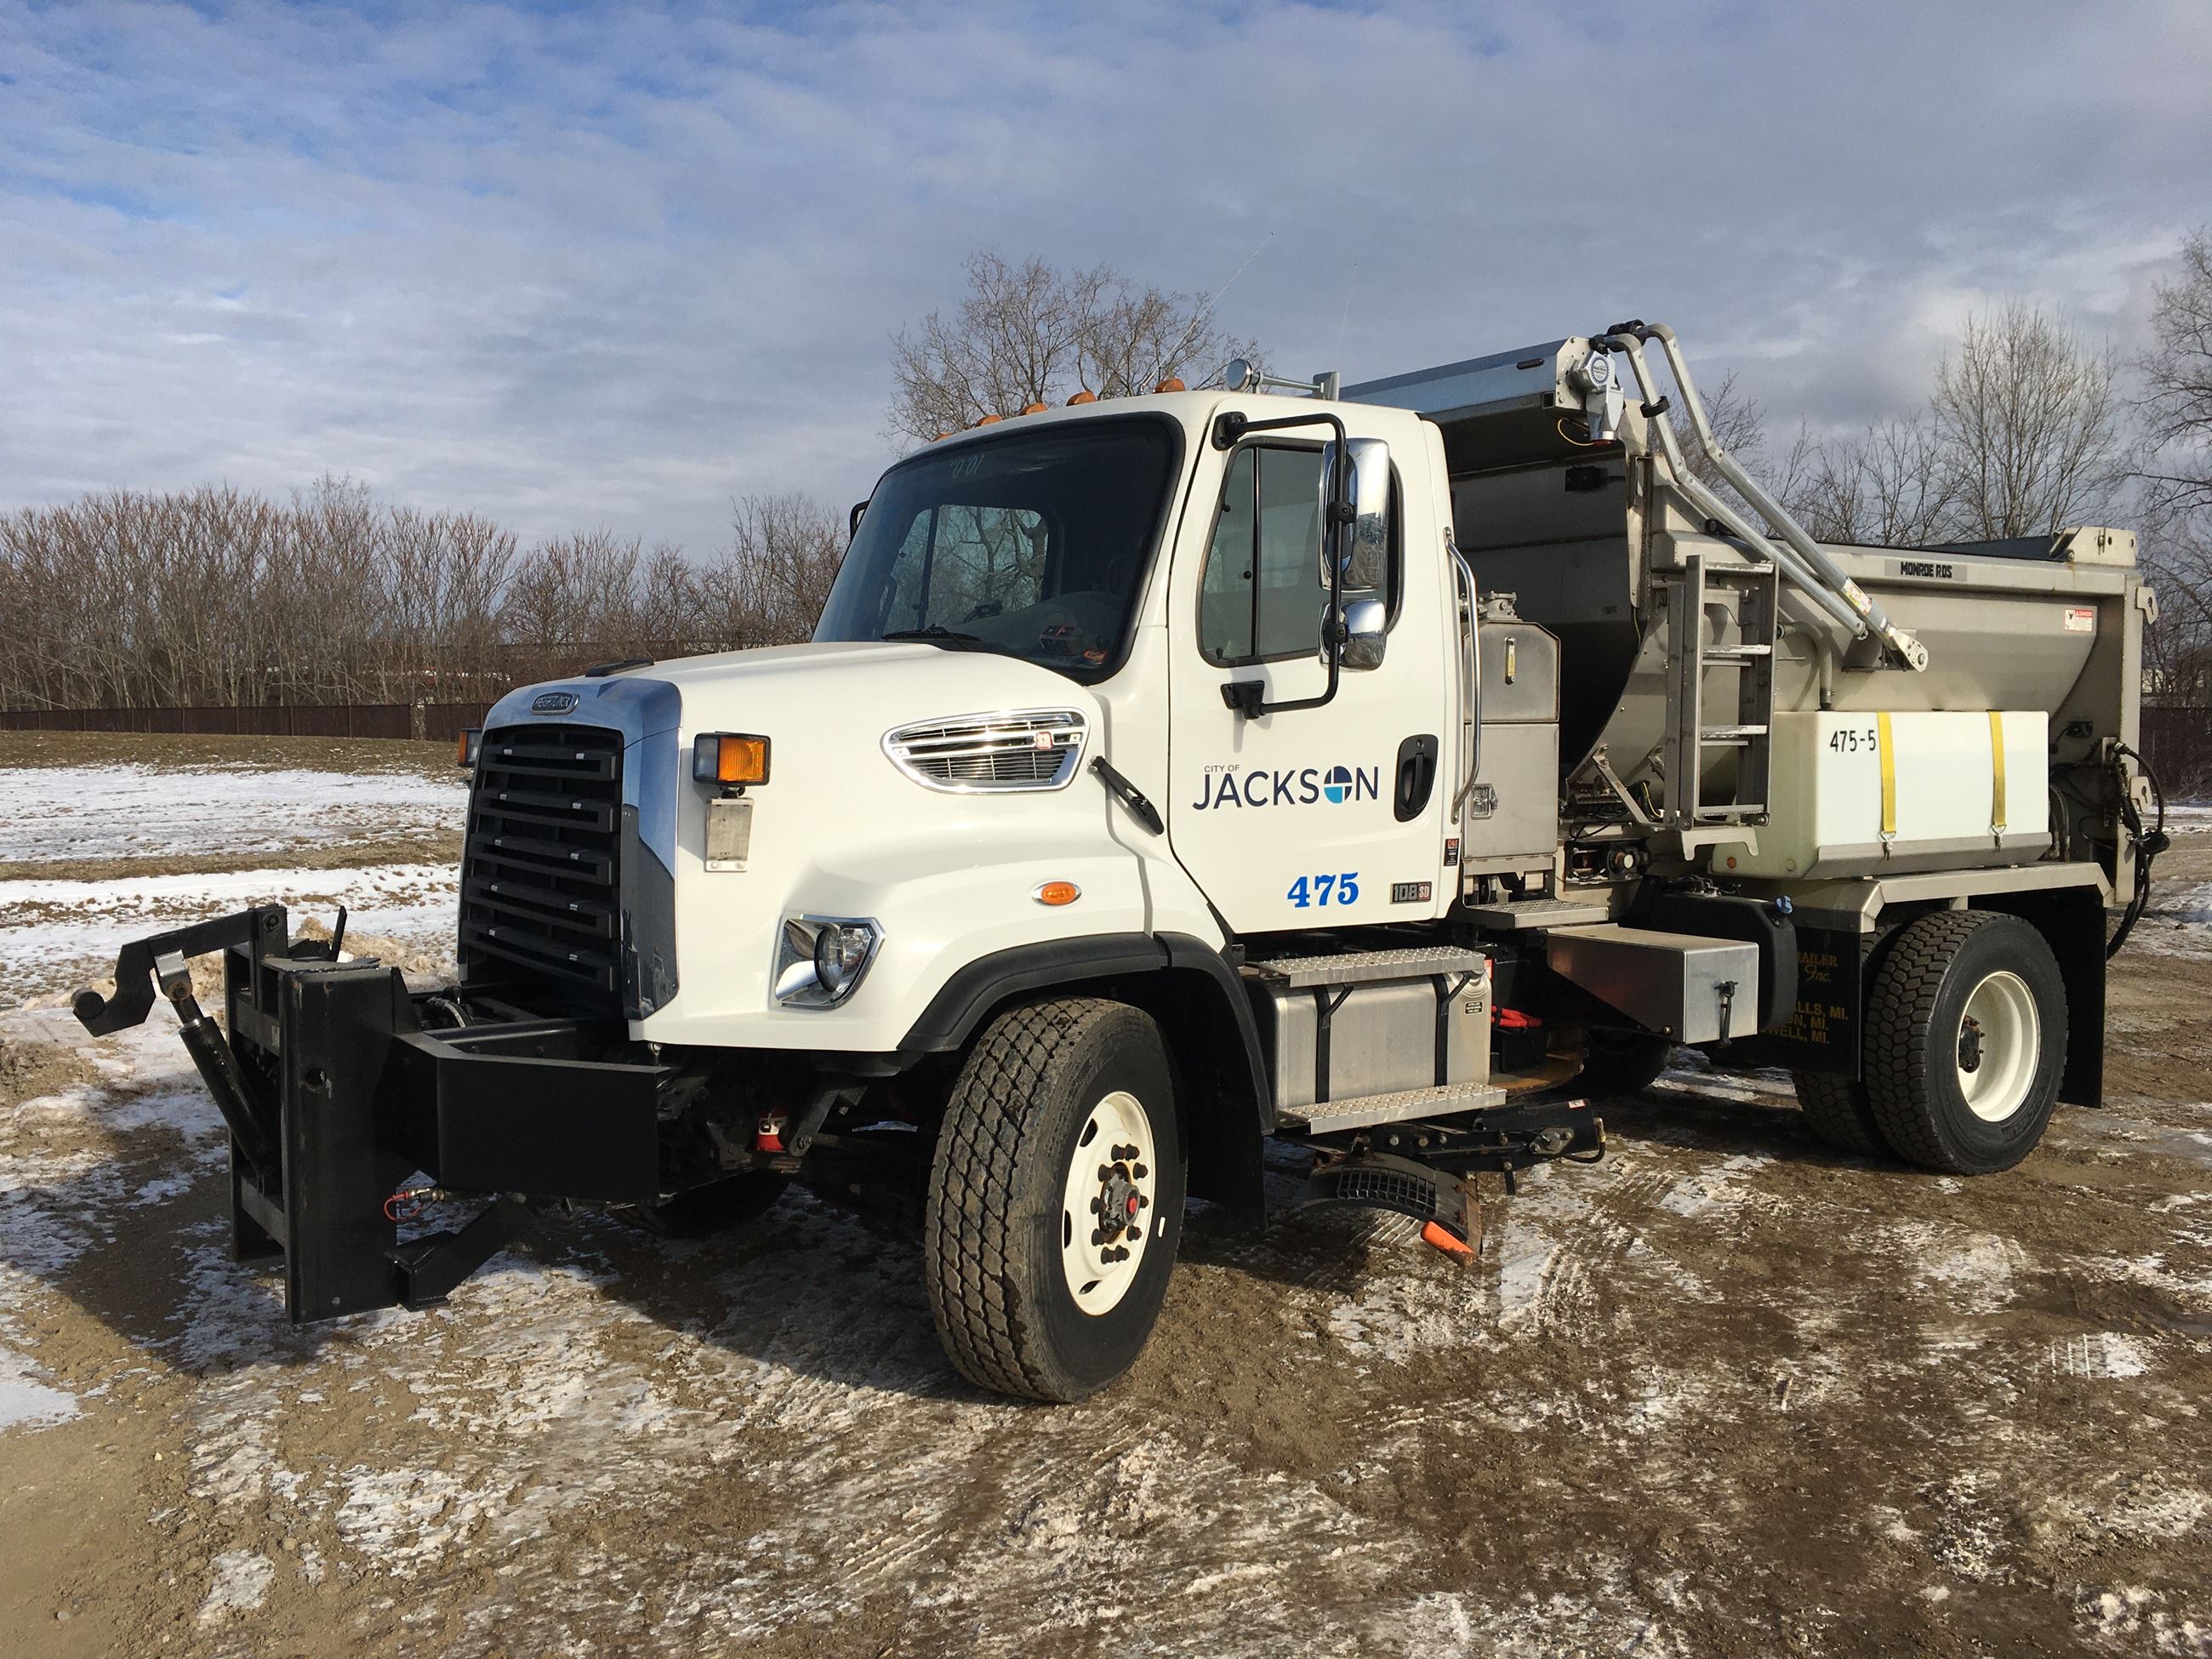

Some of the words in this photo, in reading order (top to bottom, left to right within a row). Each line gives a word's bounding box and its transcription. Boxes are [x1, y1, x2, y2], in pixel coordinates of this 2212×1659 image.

[1900, 562, 1934, 577] MONROE
[1936, 564, 1953, 579] RDS
[1830, 729, 1876, 752] 475-5
[1192, 766, 1378, 810] JACKSON
[1286, 872, 1360, 908] 475
[1796, 951, 1838, 966] RAILER
[1804, 965, 1832, 982] Inc.
[1793, 1001, 1826, 1018] LLS,
[1829, 1006, 1849, 1020] MI.
[1810, 1016, 1829, 1030] MI.
[1759, 1023, 1808, 1042] WELL,
[1811, 1029, 1830, 1044] MI.
